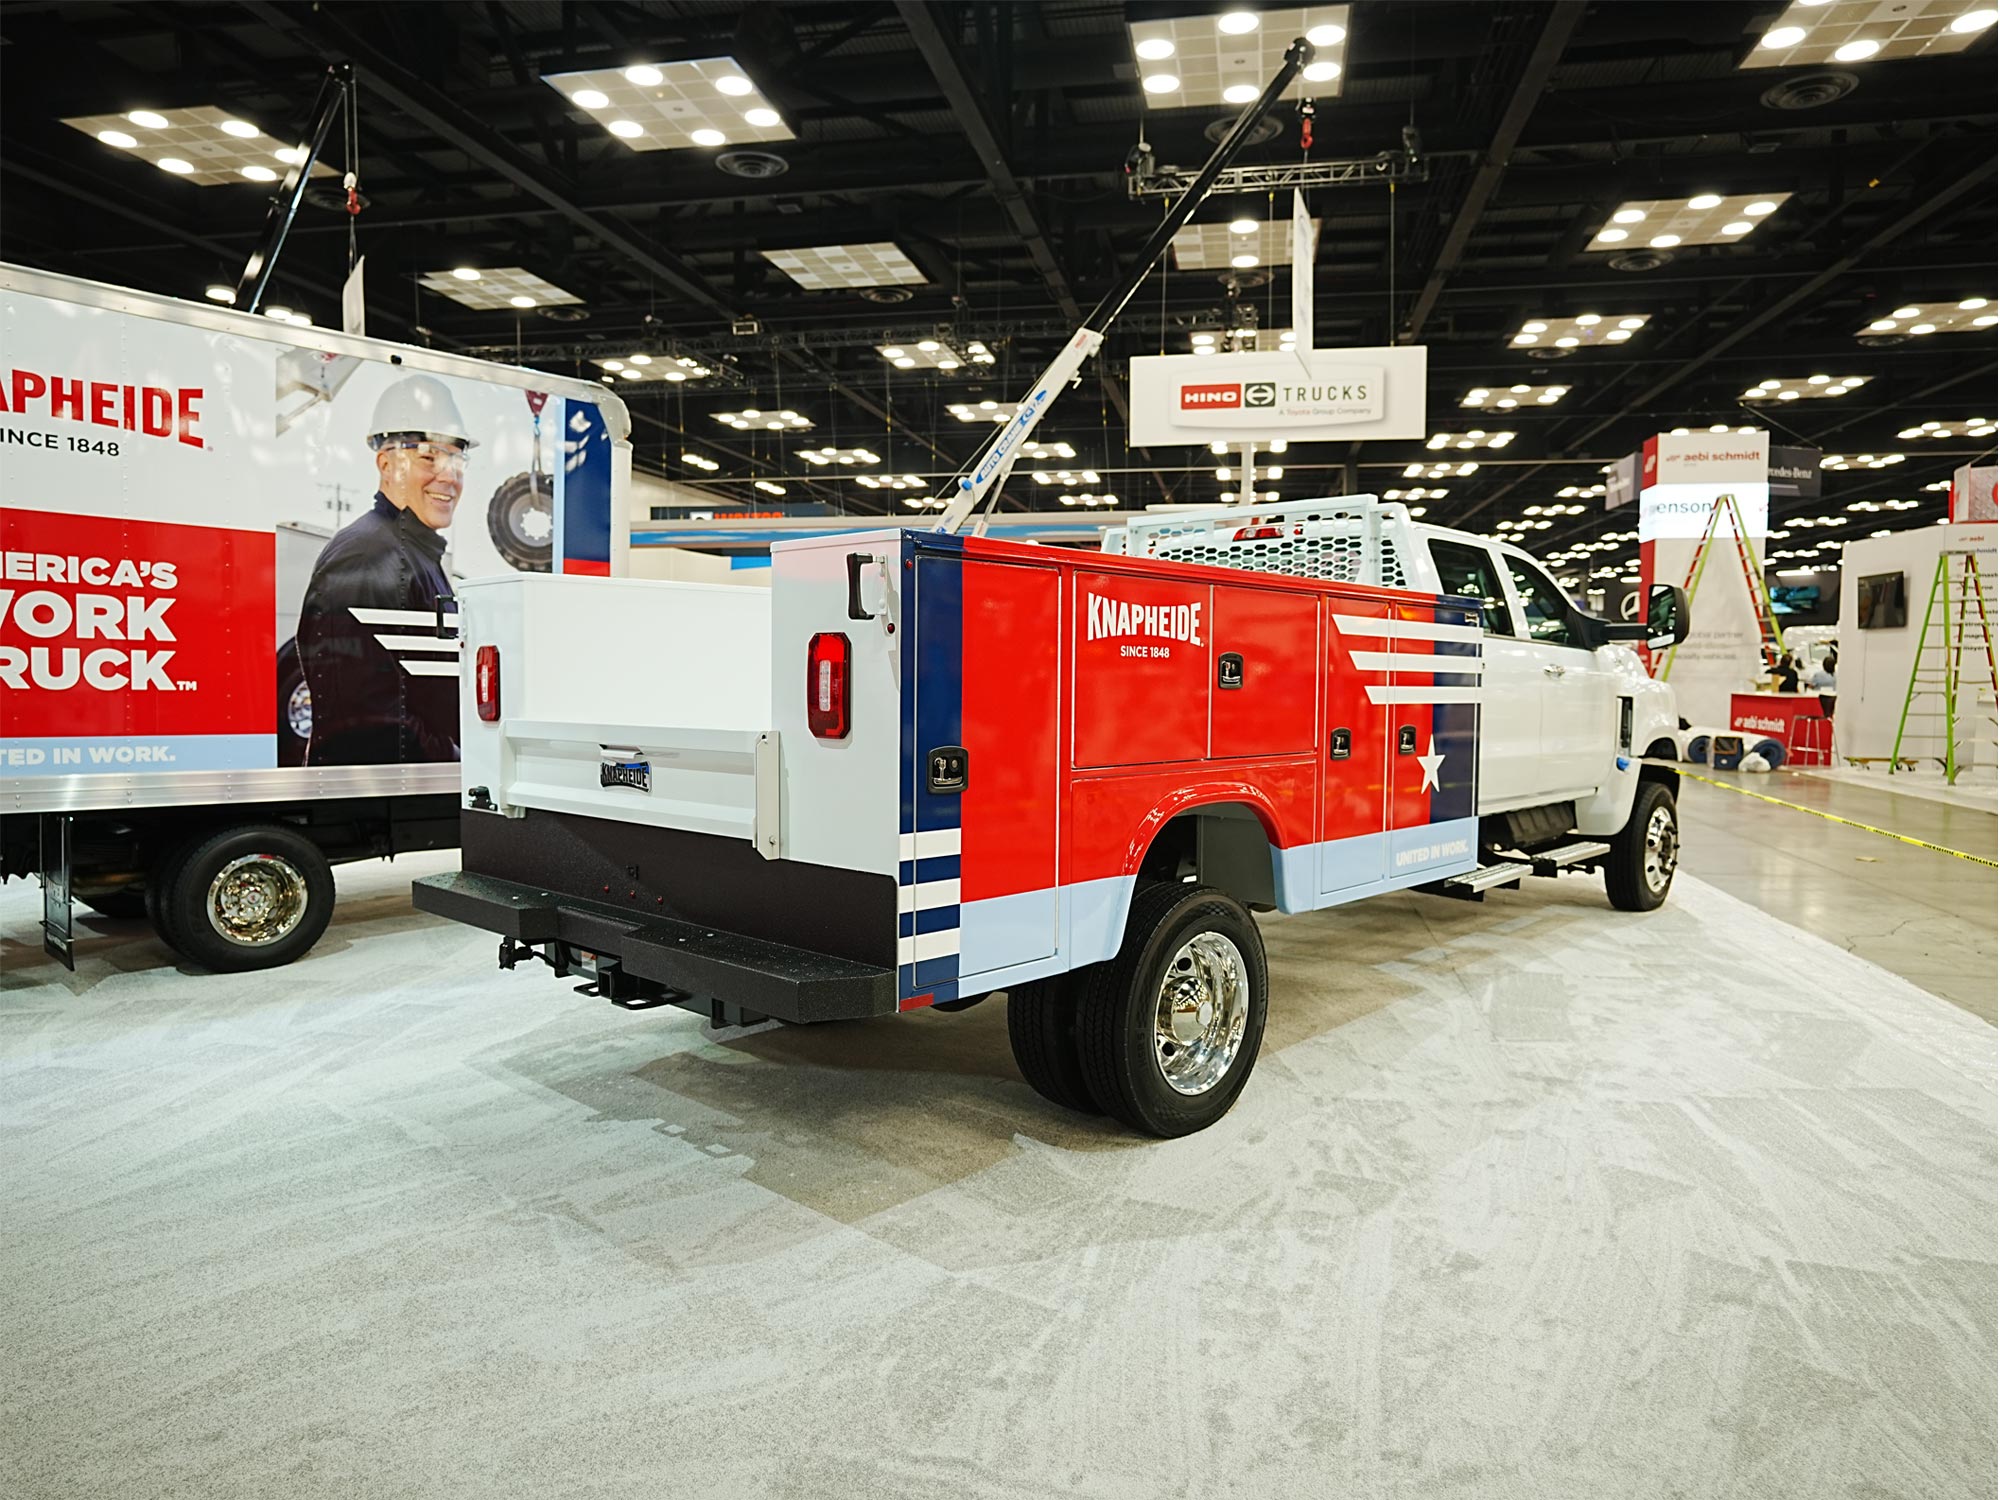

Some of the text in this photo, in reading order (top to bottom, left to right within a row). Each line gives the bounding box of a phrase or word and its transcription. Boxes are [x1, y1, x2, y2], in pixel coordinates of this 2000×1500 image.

[1184, 385, 1367, 404] HINO TRUCKS
[1312, 408, 1335, 416] Group
[1336, 407, 1372, 415] Company
[67, 436, 120, 457] 1848
[980, 420, 1024, 478] AUTO CRANE
[1683, 450, 1761, 461] aebi schmidt
[0, 551, 178, 590] ERICA'S
[1087, 592, 1202, 646] KNAPHEIDE
[1120, 645, 1170, 659] SINCE 1848
[52, 747, 81, 765] IN
[87, 746, 177, 765] WORK.
[601, 762, 648, 788] KNAPHEIDE
[1396, 839, 1469, 867] UNITED IN WORK.
